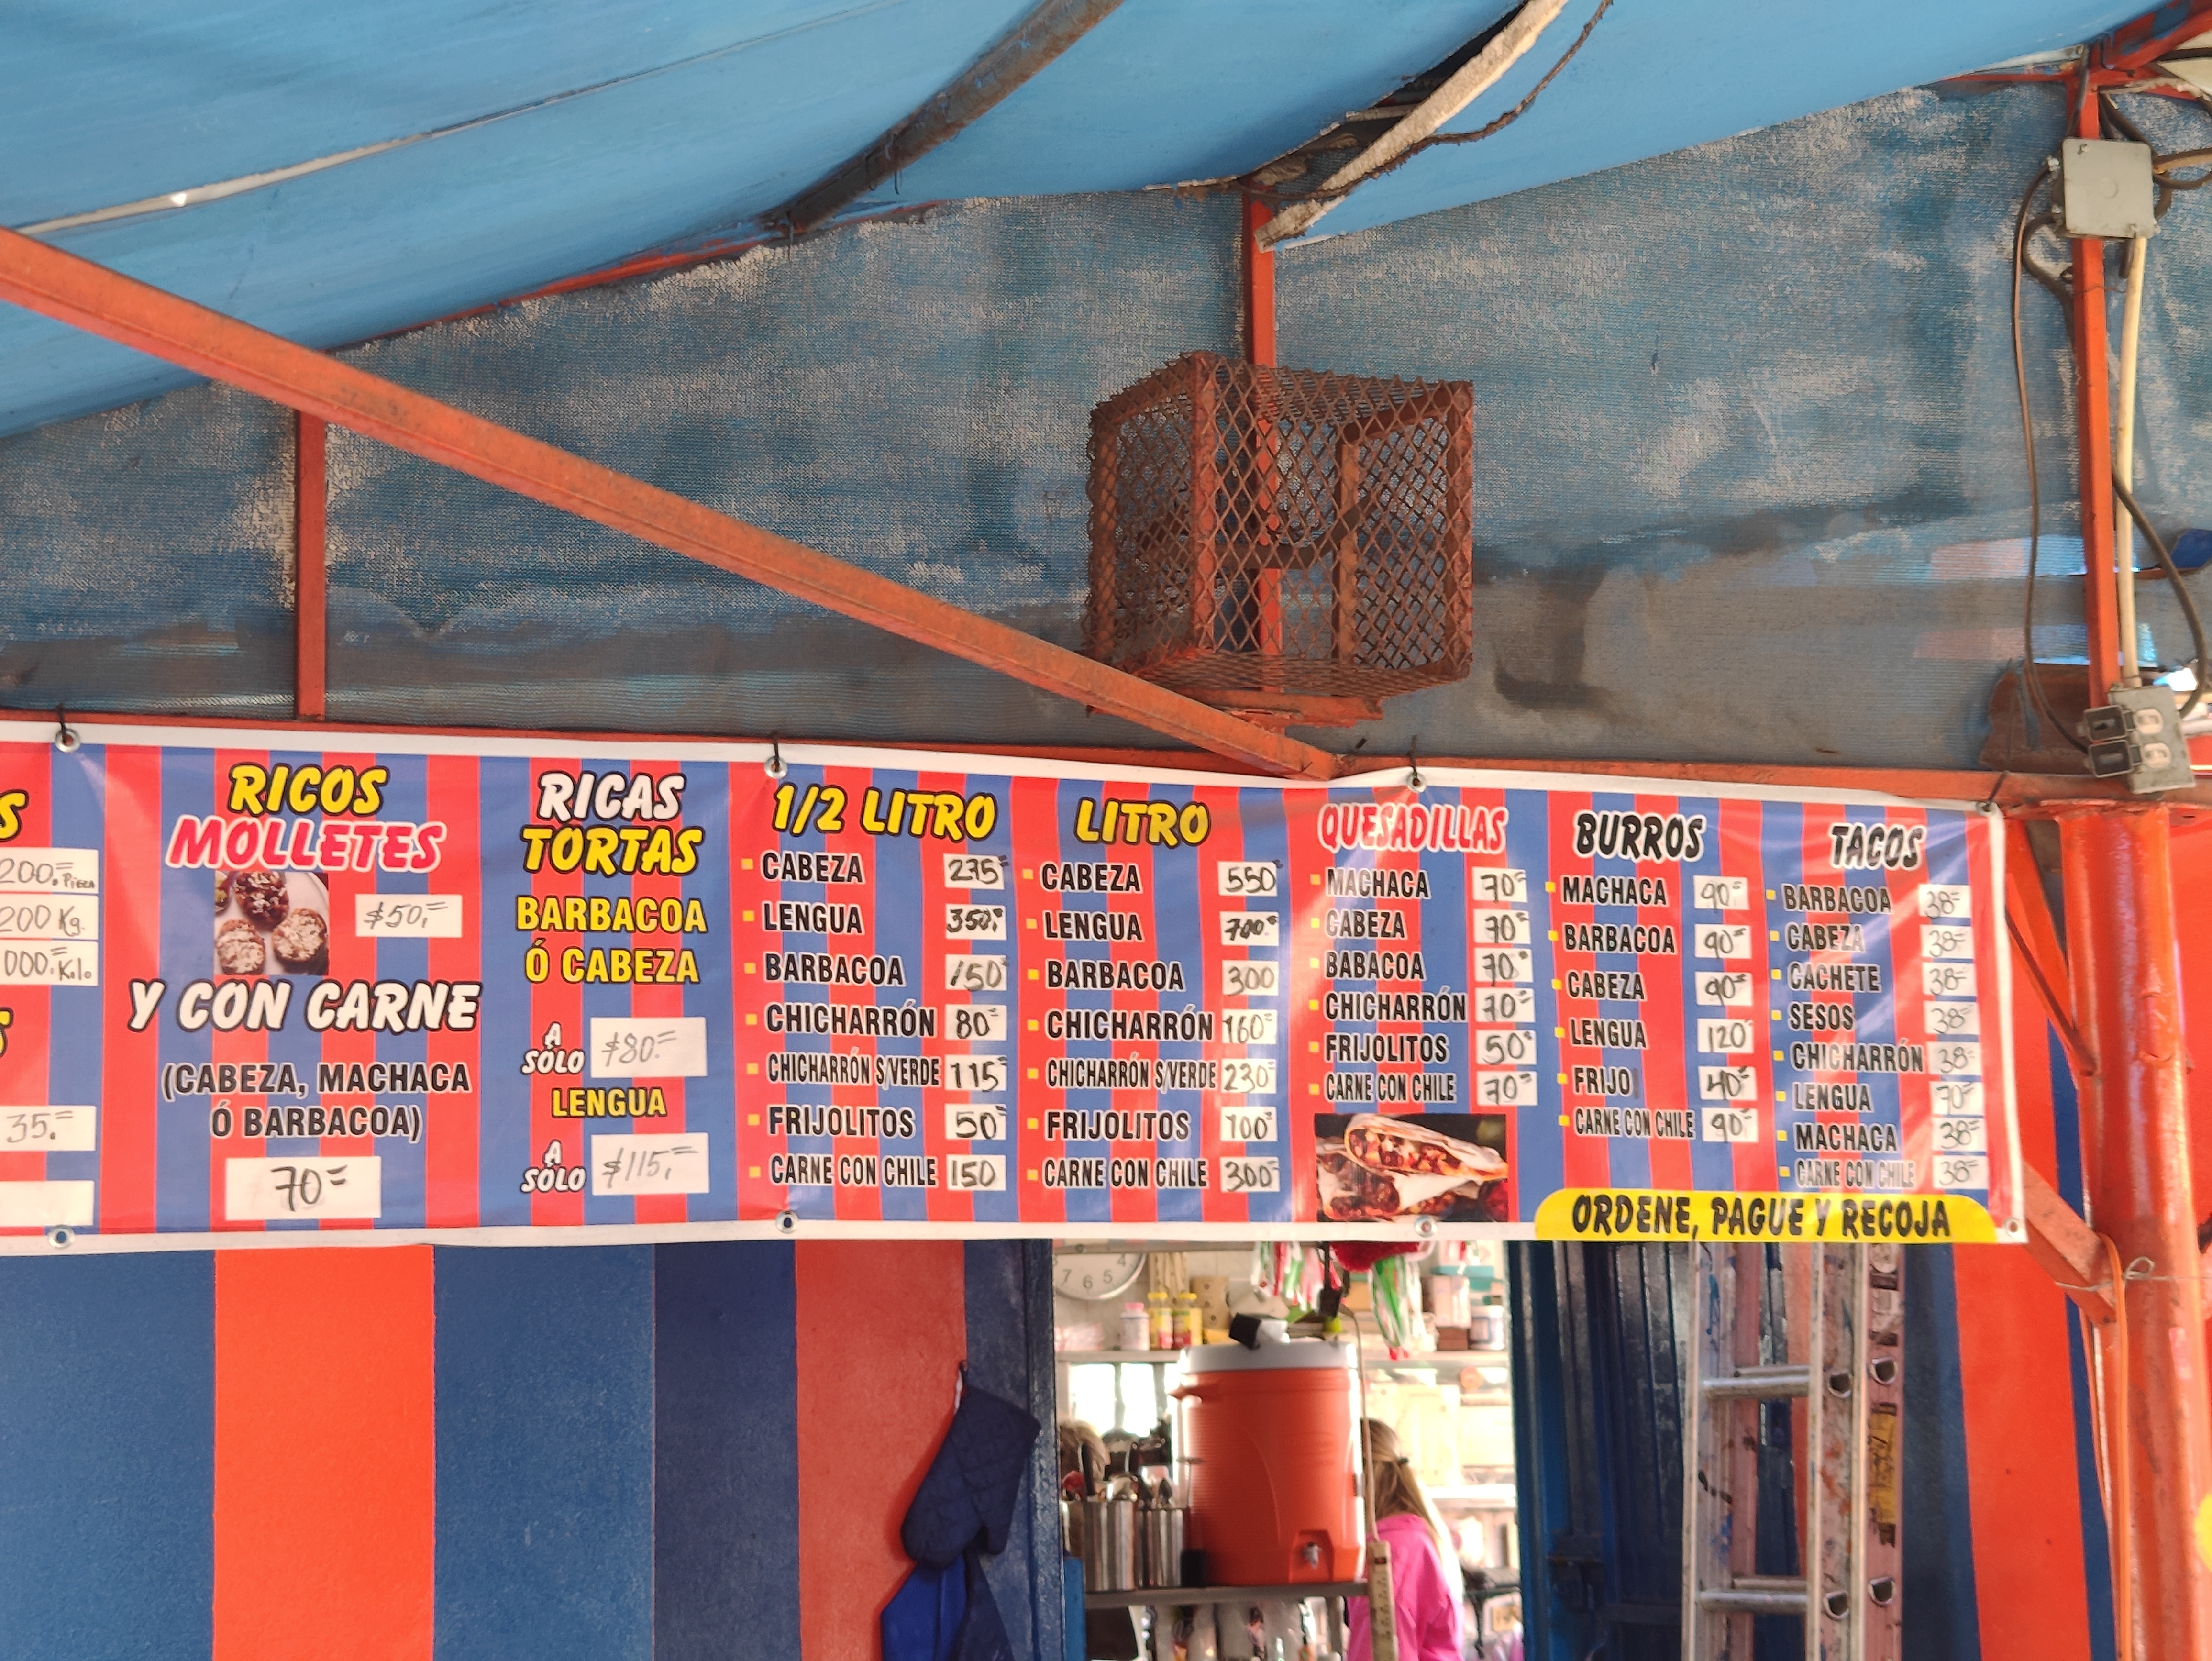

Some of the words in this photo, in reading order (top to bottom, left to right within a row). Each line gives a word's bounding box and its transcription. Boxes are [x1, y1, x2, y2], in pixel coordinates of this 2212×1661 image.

[227, 762, 390, 816] RICOS
[536, 771, 686, 822] RICAS
[772, 782, 847, 837] 1/2
[860, 787, 997, 842] LITRO
[1074, 797, 1211, 848] LITRO
[1318, 802, 1509, 853] QUESADILLAS
[165, 814, 448, 872] MOLLETES
[520, 824, 704, 877] TORTAS
[1574, 810, 1706, 863] BURROS
[1829, 823, 1927, 871] TACOS
[762, 851, 864, 884] CABEZA
[1041, 863, 1143, 893] CABEZA
[1326, 868, 1431, 898] MACHACA
[1562, 876, 1668, 906] MACHACA
[1782, 884, 1892, 914] BARBACOA
[516, 896, 708, 933] BARBACOA
[763, 902, 863, 935] LENGUA
[1044, 911, 1144, 942] LENGUA
[1325, 909, 1407, 939] CABEZA
[1563, 923, 1676, 954] BARBACOA
[1786, 923, 1865, 952] CABEZA
[524, 938, 550, 983] Ó
[561, 946, 701, 985] CABEZA
[765, 952, 906, 986] BARBACOA
[1047, 959, 1186, 991] BARBACOA
[1325, 951, 1426, 981] BABACOA
[1789, 963, 1882, 992] CACHETE
[1228, 966, 1275, 996] 300
[1567, 970, 1646, 1001] CABEZA
[128, 979, 166, 1031] Y
[177, 979, 292, 1032] CON
[304, 980, 482, 1033] CARNE
[766, 999, 935, 1037] CHICHARRÓN
[1325, 986, 1468, 1022] CHICHARRÓN
[1789, 1002, 1855, 1031] SESOS
[542, 1021, 563, 1048] A
[1047, 1004, 1214, 1041] CHICHARRÓN
[1570, 1018, 1648, 1049] LENGUA
[1325, 1033, 1449, 1062] FRIJOLITOS
[1792, 1038, 1924, 1073] CHICHARRÓN
[164, 1062, 308, 1101] (CABEZA,
[317, 1061, 473, 1094] MACHACA
[768, 1046, 871, 1085] CHICHARRÓN
[875, 1055, 940, 1090] S/VERDE
[1047, 1052, 1150, 1089] CHICHARRÓN
[1155, 1061, 1217, 1093] S/VERDE
[551, 1086, 667, 1118] LENGUA
[1325, 1073, 1372, 1102] CARNE
[1378, 1074, 1407, 1102] CON
[1412, 1074, 1456, 1102] CHILE
[1793, 1083, 1873, 1112] LENGUA
[211, 1101, 232, 1138] Ó
[242, 1105, 422, 1143] BARBACOA)
[768, 1105, 915, 1137] FRIJOLITOS
[1046, 1110, 1191, 1141] FRIJOLITOS
[1574, 1108, 1620, 1136] CARNE
[1626, 1109, 1653, 1138] CON
[1655, 1109, 1695, 1139] CHILE
[542, 1139, 563, 1166] A
[1795, 1123, 1899, 1152] MACHACA
[771, 1154, 833, 1185] CARNE
[839, 1155, 877, 1186] CON
[883, 1156, 937, 1186] CHILE
[1044, 1158, 1105, 1188] CARNE
[1111, 1159, 1149, 1188] CON
[1156, 1159, 1208, 1188] CHILE
[1795, 1159, 1840, 1187] CARNE
[1846, 1160, 1874, 1188] CON
[1878, 1160, 1916, 1189] CHILE
[1572, 1195, 1698, 1240] ORDENE,
[1712, 1197, 1804, 1236] PAGUE
[1815, 1198, 1831, 1236] Y
[1841, 1199, 1951, 1239] RECOJA
[1083, 1275, 1093, 1289] 6
[1103, 1269, 1113, 1284] 5
